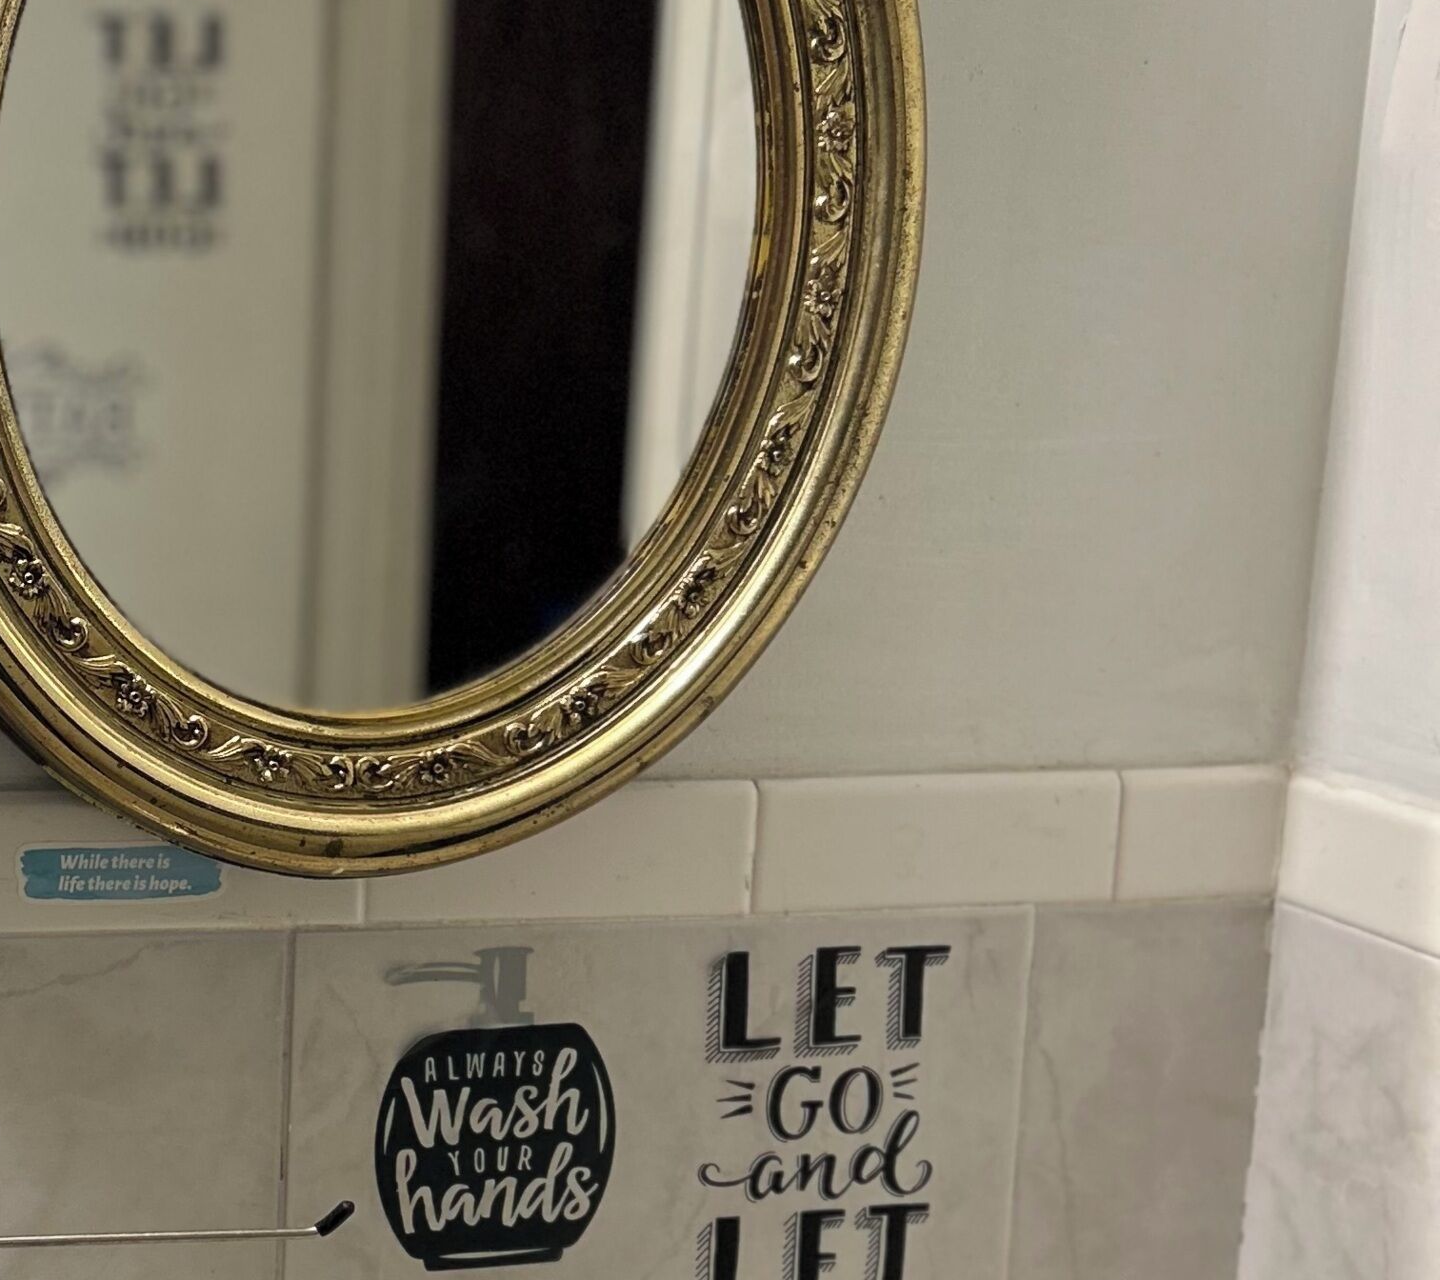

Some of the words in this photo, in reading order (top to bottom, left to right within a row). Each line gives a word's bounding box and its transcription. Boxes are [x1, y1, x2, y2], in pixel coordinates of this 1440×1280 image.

[58, 875, 85, 892] life
[88, 876, 131, 891] there
[133, 875, 146, 890] is
[149, 875, 192, 893] hope.
[60, 854, 108, 869] While
[111, 854, 154, 869] there
[157, 853, 170, 869] is
[706, 945, 951, 1063] LET
[400, 1047, 588, 1148] Wash
[424, 1050, 546, 1083] ALWAYS
[766, 1065, 883, 1142] GO
[395, 1142, 598, 1233] hands
[447, 1146, 533, 1176] YOUR
[698, 1109, 932, 1201] and
